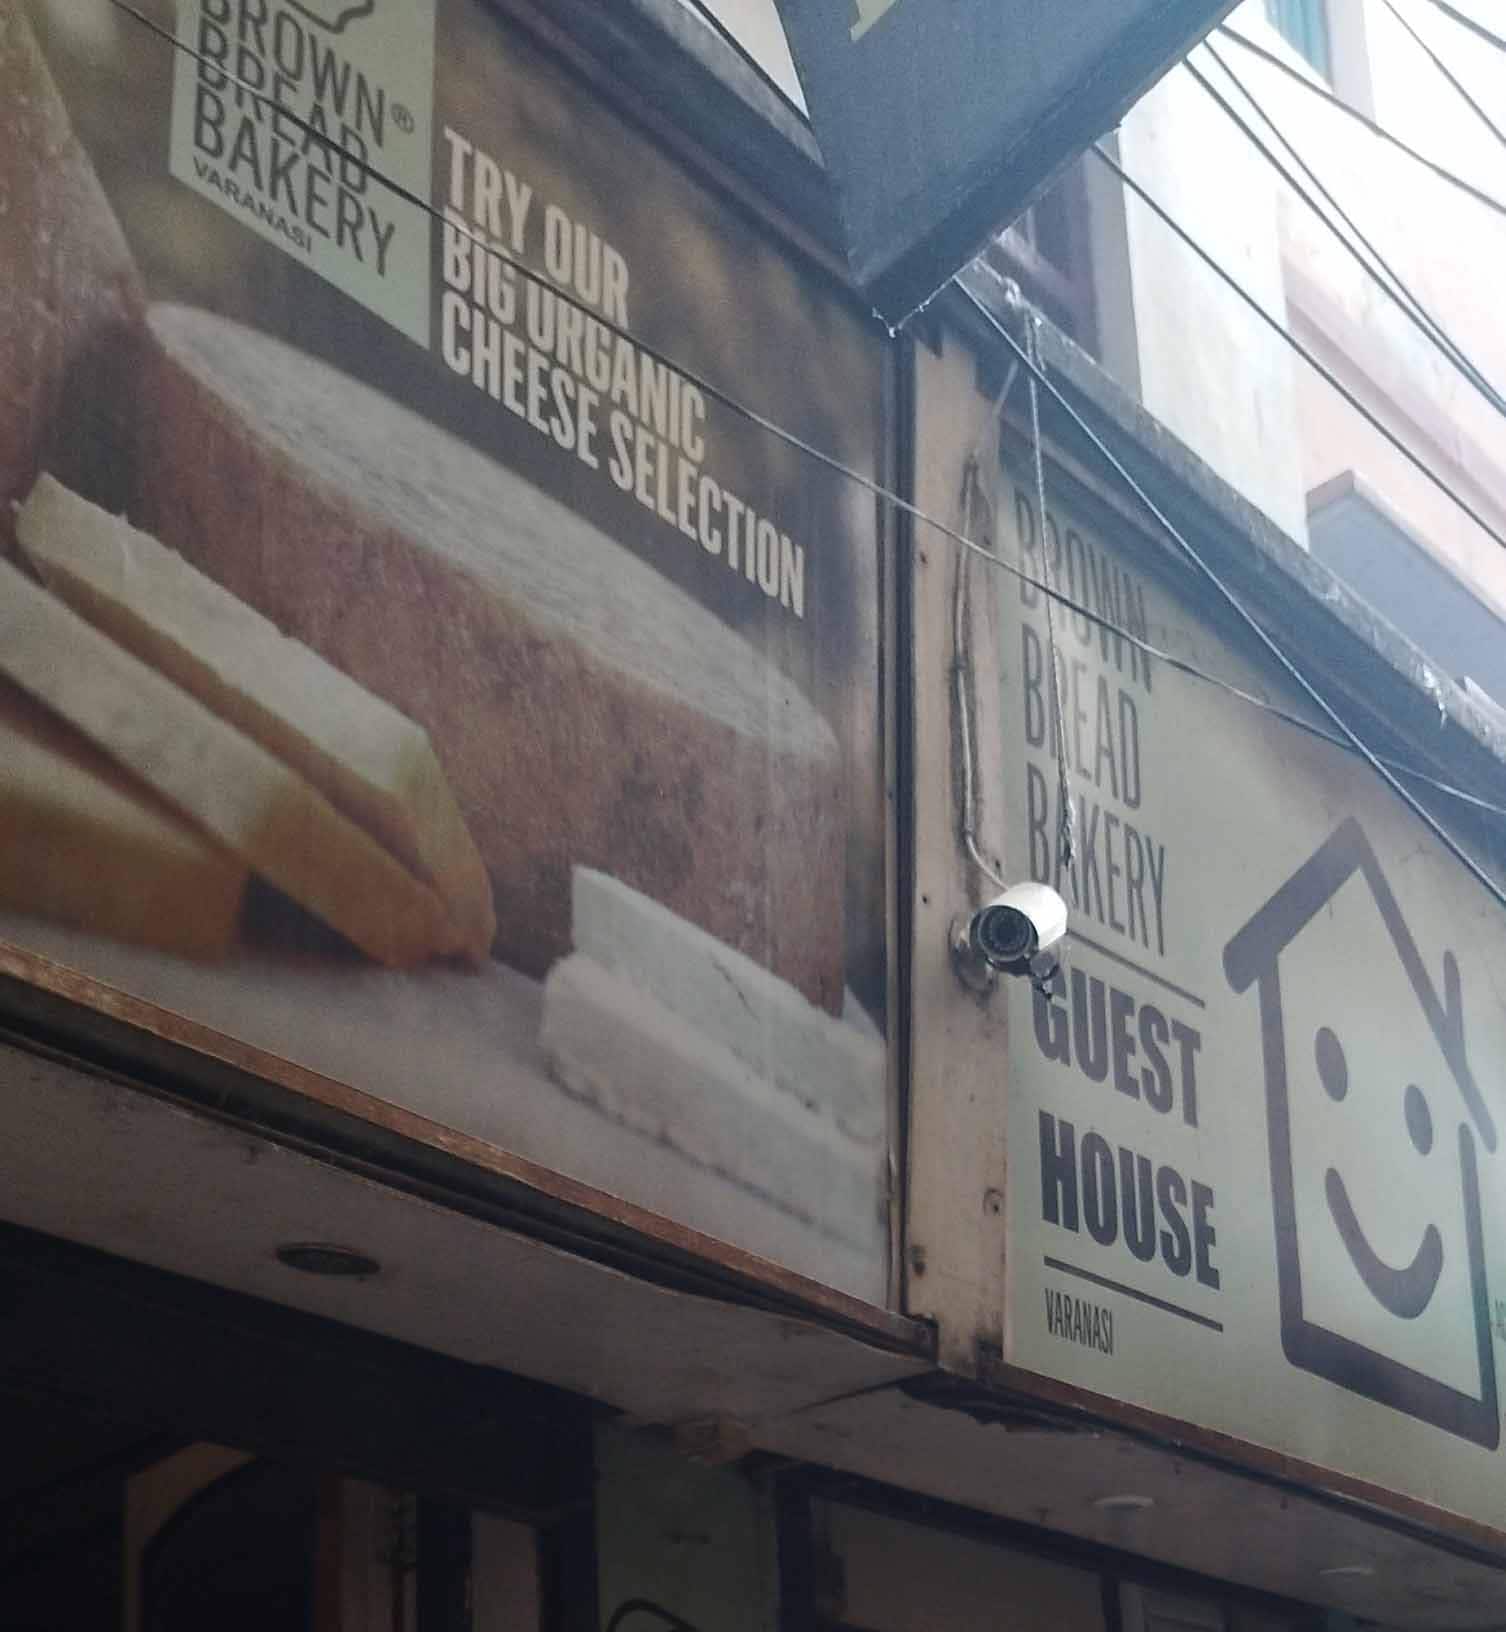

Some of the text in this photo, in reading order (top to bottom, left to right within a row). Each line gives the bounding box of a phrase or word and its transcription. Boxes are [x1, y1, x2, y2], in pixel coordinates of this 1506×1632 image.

[194, 83, 395, 278] BAKERY
[197, 18, 368, 196] BREAD
[193, 155, 312, 255] VARANASI
[444, 127, 630, 328] TRY OUR
[443, 205, 707, 462] BIG ORGANIC
[442, 292, 804, 619] CHEESE SELECTION
[1014, 487, 1153, 694] BROWN
[1021, 622, 1142, 810] BREAD
[1027, 761, 1166, 958] BAKERY
[1032, 955, 1201, 1129] GUEST
[1038, 1108, 1221, 1291] HOUSE
[1044, 1287, 1114, 1356] VARANASI
